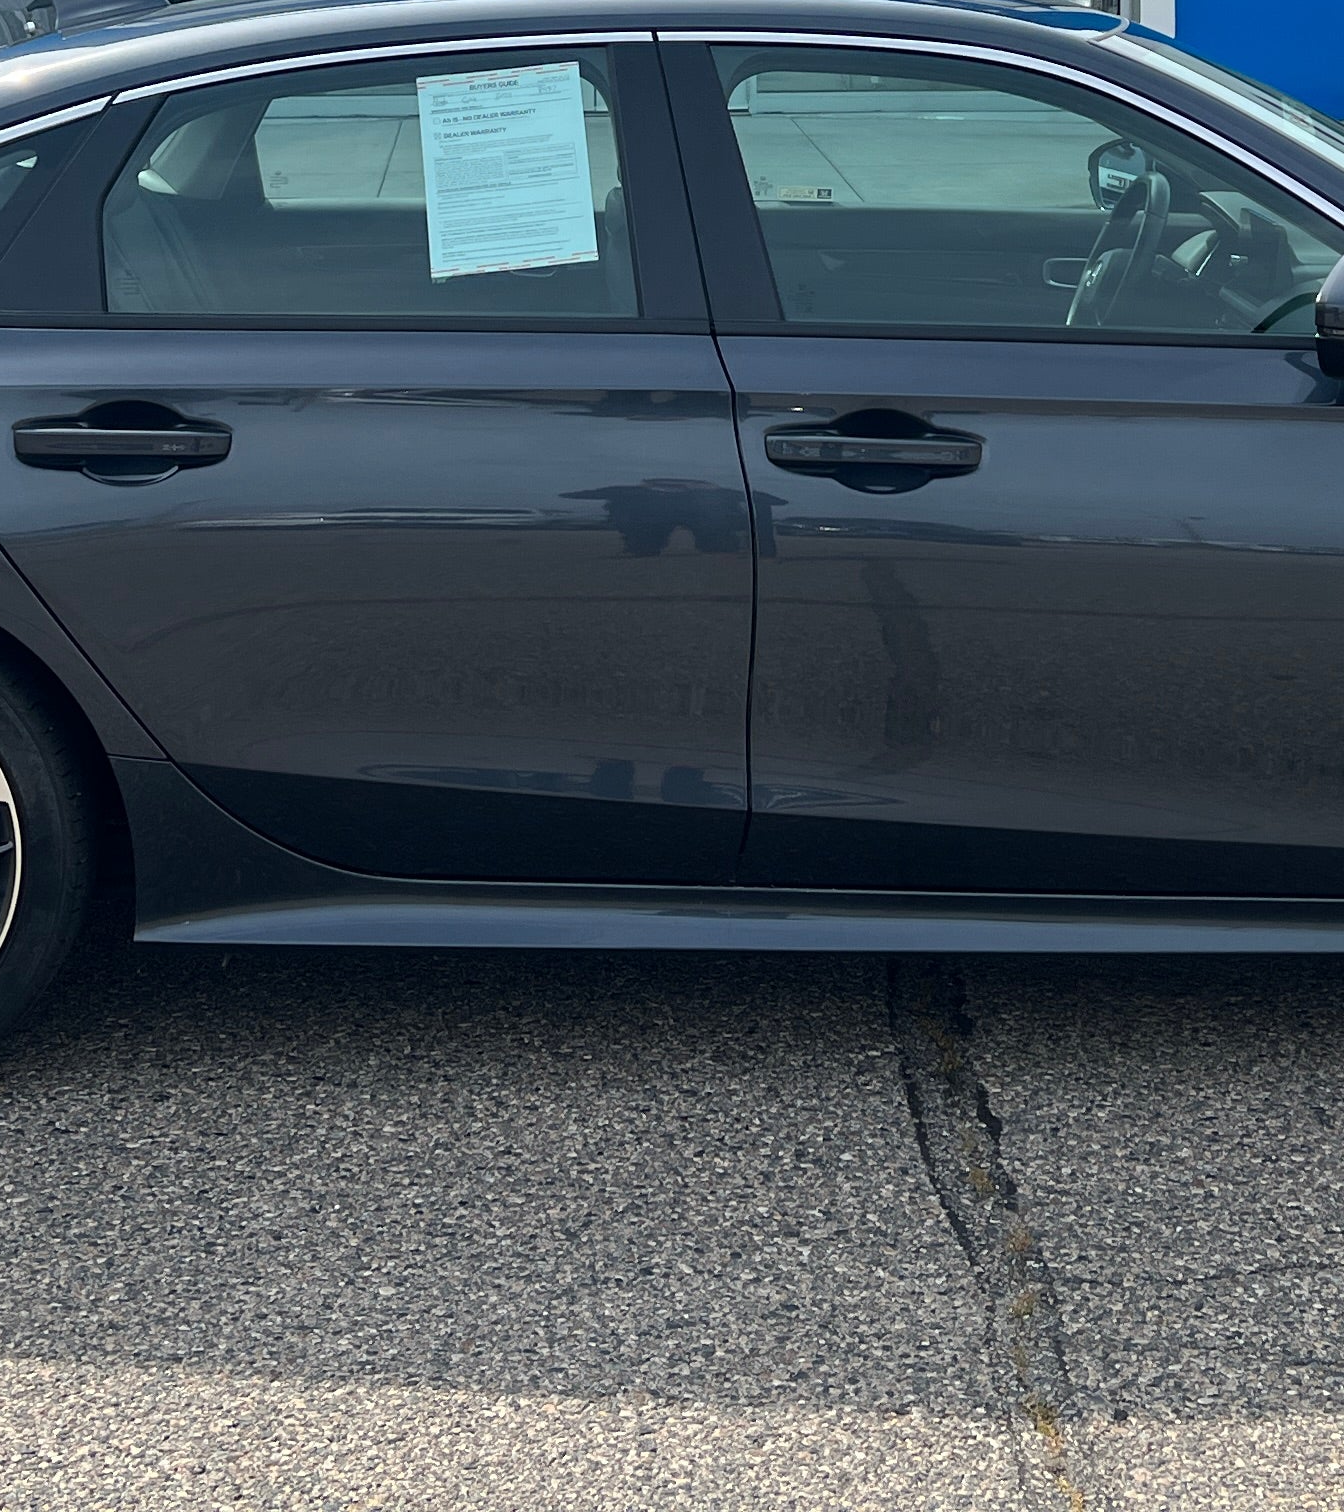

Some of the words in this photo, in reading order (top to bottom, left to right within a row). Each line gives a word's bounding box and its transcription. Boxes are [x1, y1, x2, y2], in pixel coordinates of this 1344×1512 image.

[498, 80, 519, 88] GUIDE
[500, 108, 537, 118] WARRANTY
[471, 127, 507, 137] WARRANTY
